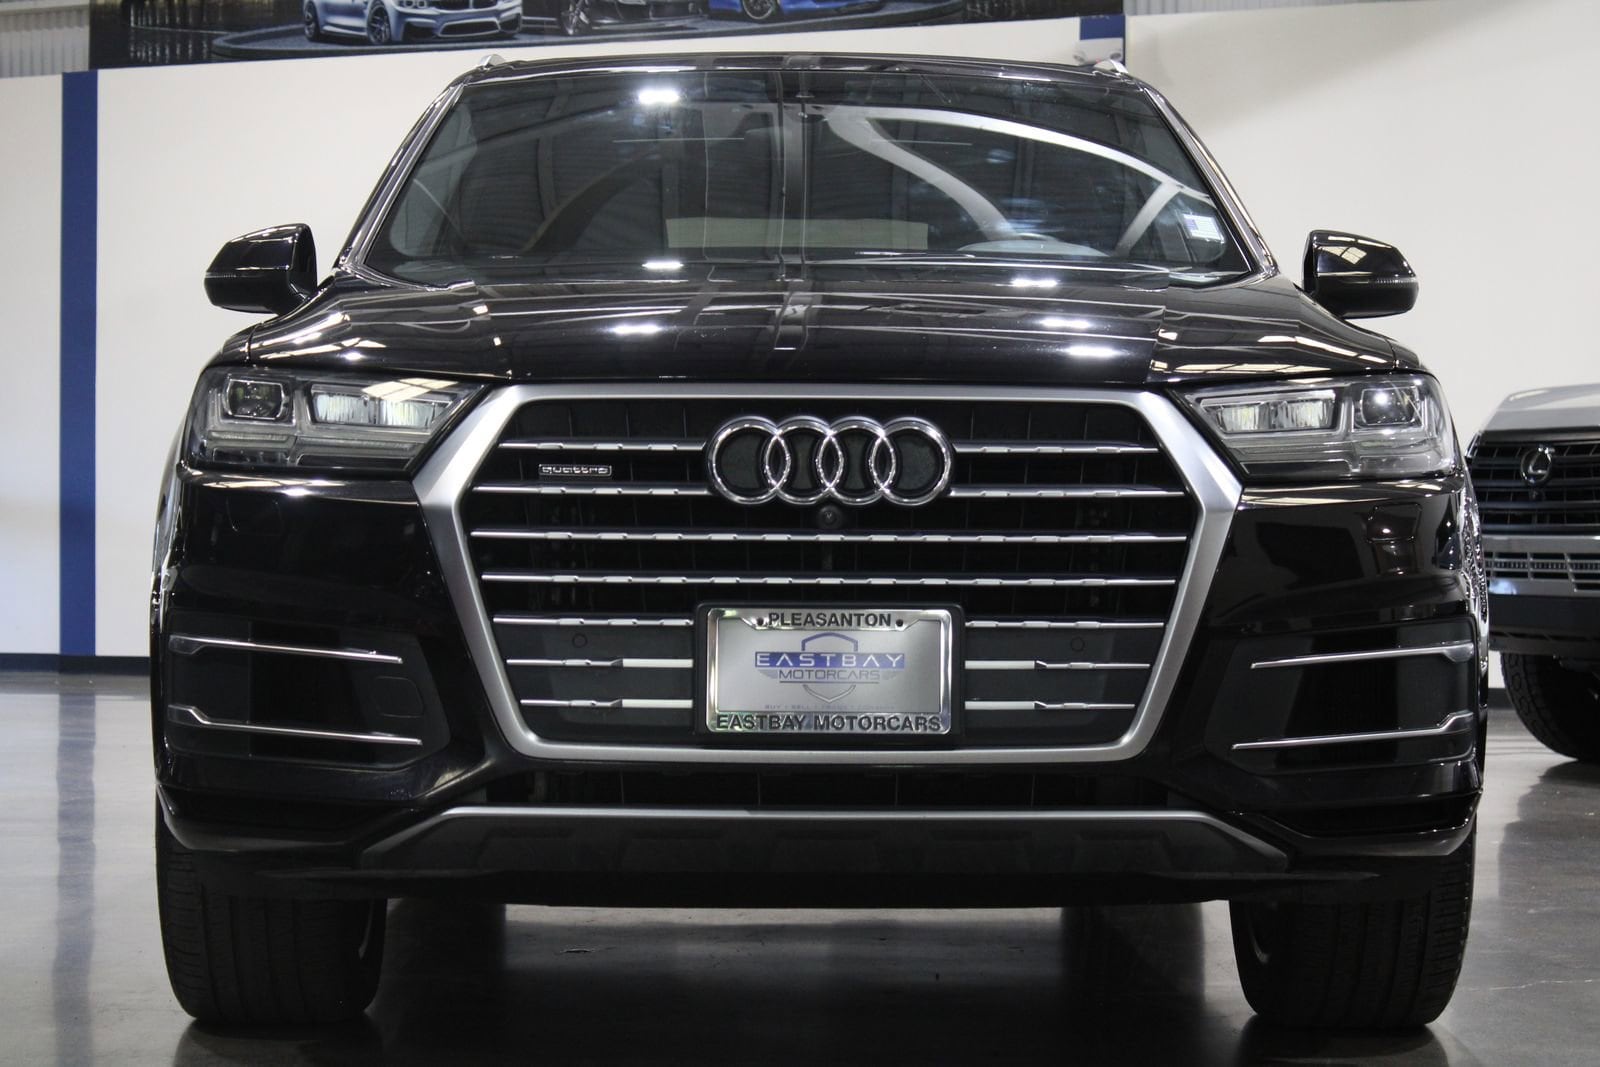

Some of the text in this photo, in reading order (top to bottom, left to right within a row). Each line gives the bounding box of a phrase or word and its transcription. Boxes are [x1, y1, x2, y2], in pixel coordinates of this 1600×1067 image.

[542, 466, 608, 475] quattro
[768, 612, 891, 628] PLEASANTON
[756, 653, 904, 667] EASTBAY
[778, 669, 880, 680] MOTORCARS
[716, 714, 941, 732] EASTBAY MOTORCARS
